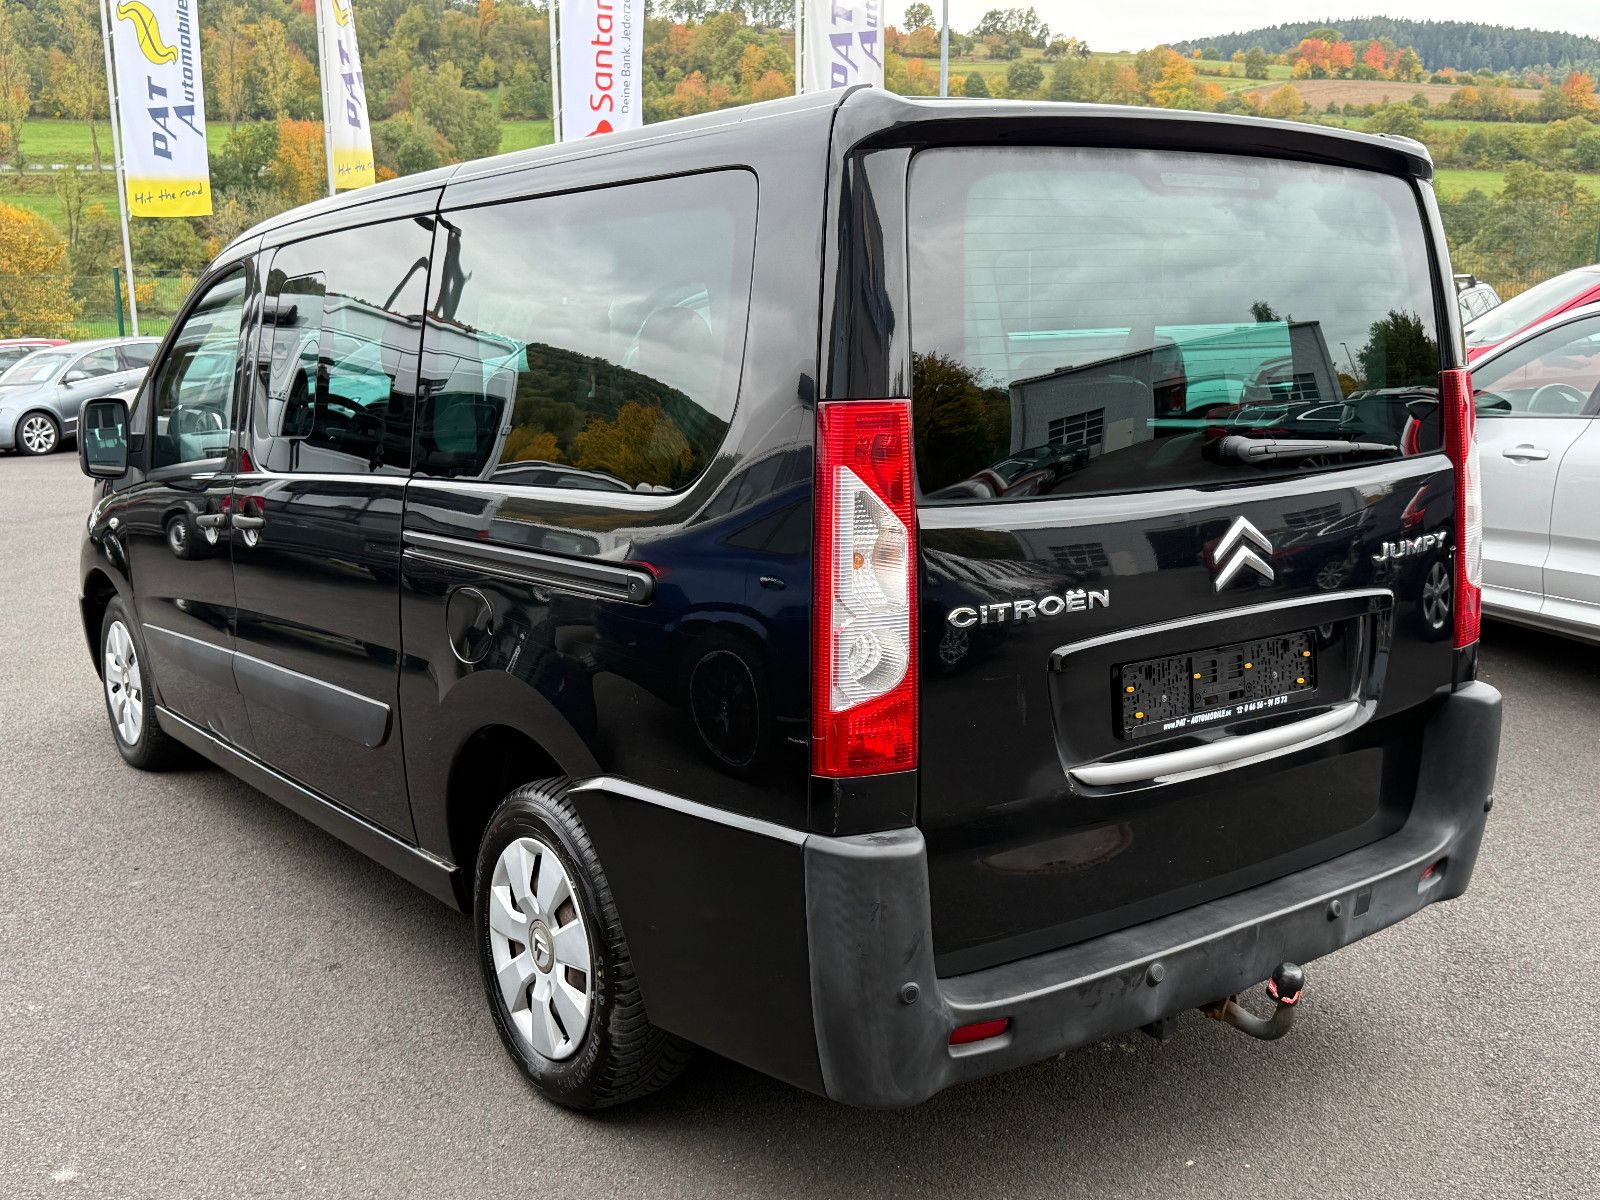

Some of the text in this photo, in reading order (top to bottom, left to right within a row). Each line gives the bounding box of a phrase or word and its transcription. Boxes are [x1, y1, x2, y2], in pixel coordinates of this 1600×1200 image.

[620, 44, 631, 78] Bank.
[620, 80, 631, 114] Deine
[147, 75, 177, 161] PAT
[135, 182, 204, 205] Hit the road
[1372, 531, 1447, 562] JUMPY
[947, 588, 1110, 629] CITROËN
